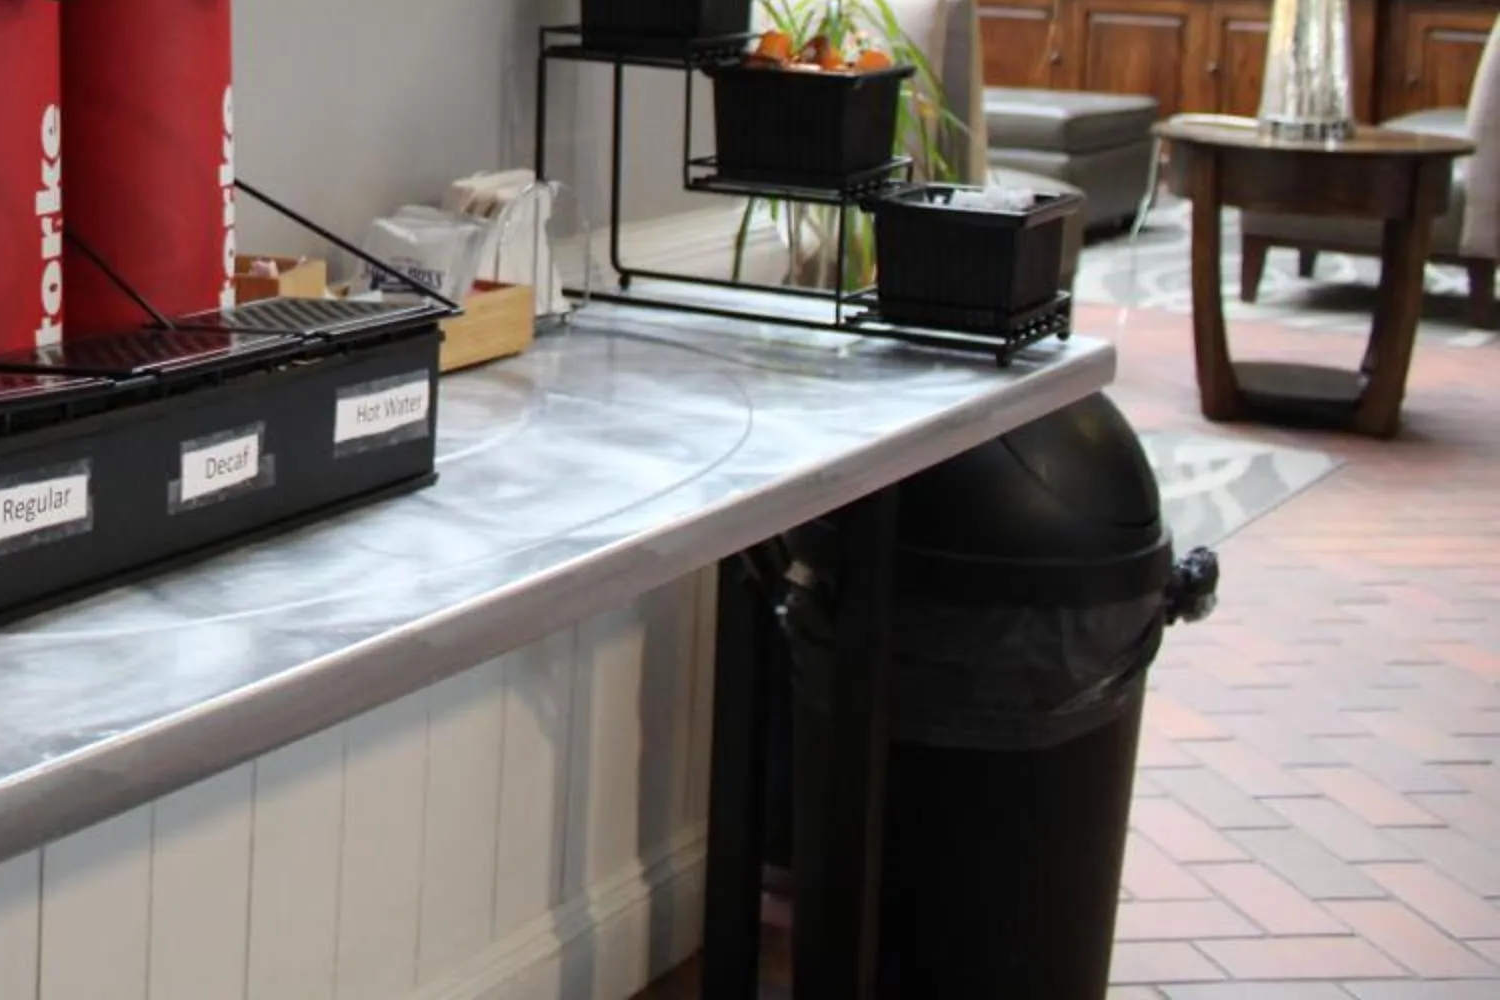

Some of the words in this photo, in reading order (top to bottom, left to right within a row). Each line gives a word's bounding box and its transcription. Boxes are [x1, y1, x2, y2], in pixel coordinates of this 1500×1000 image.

[357, 399, 380, 423] Hot
[383, 394, 422, 417] Water
[204, 444, 250, 480] Decaf
[3, 486, 71, 523] Regular
